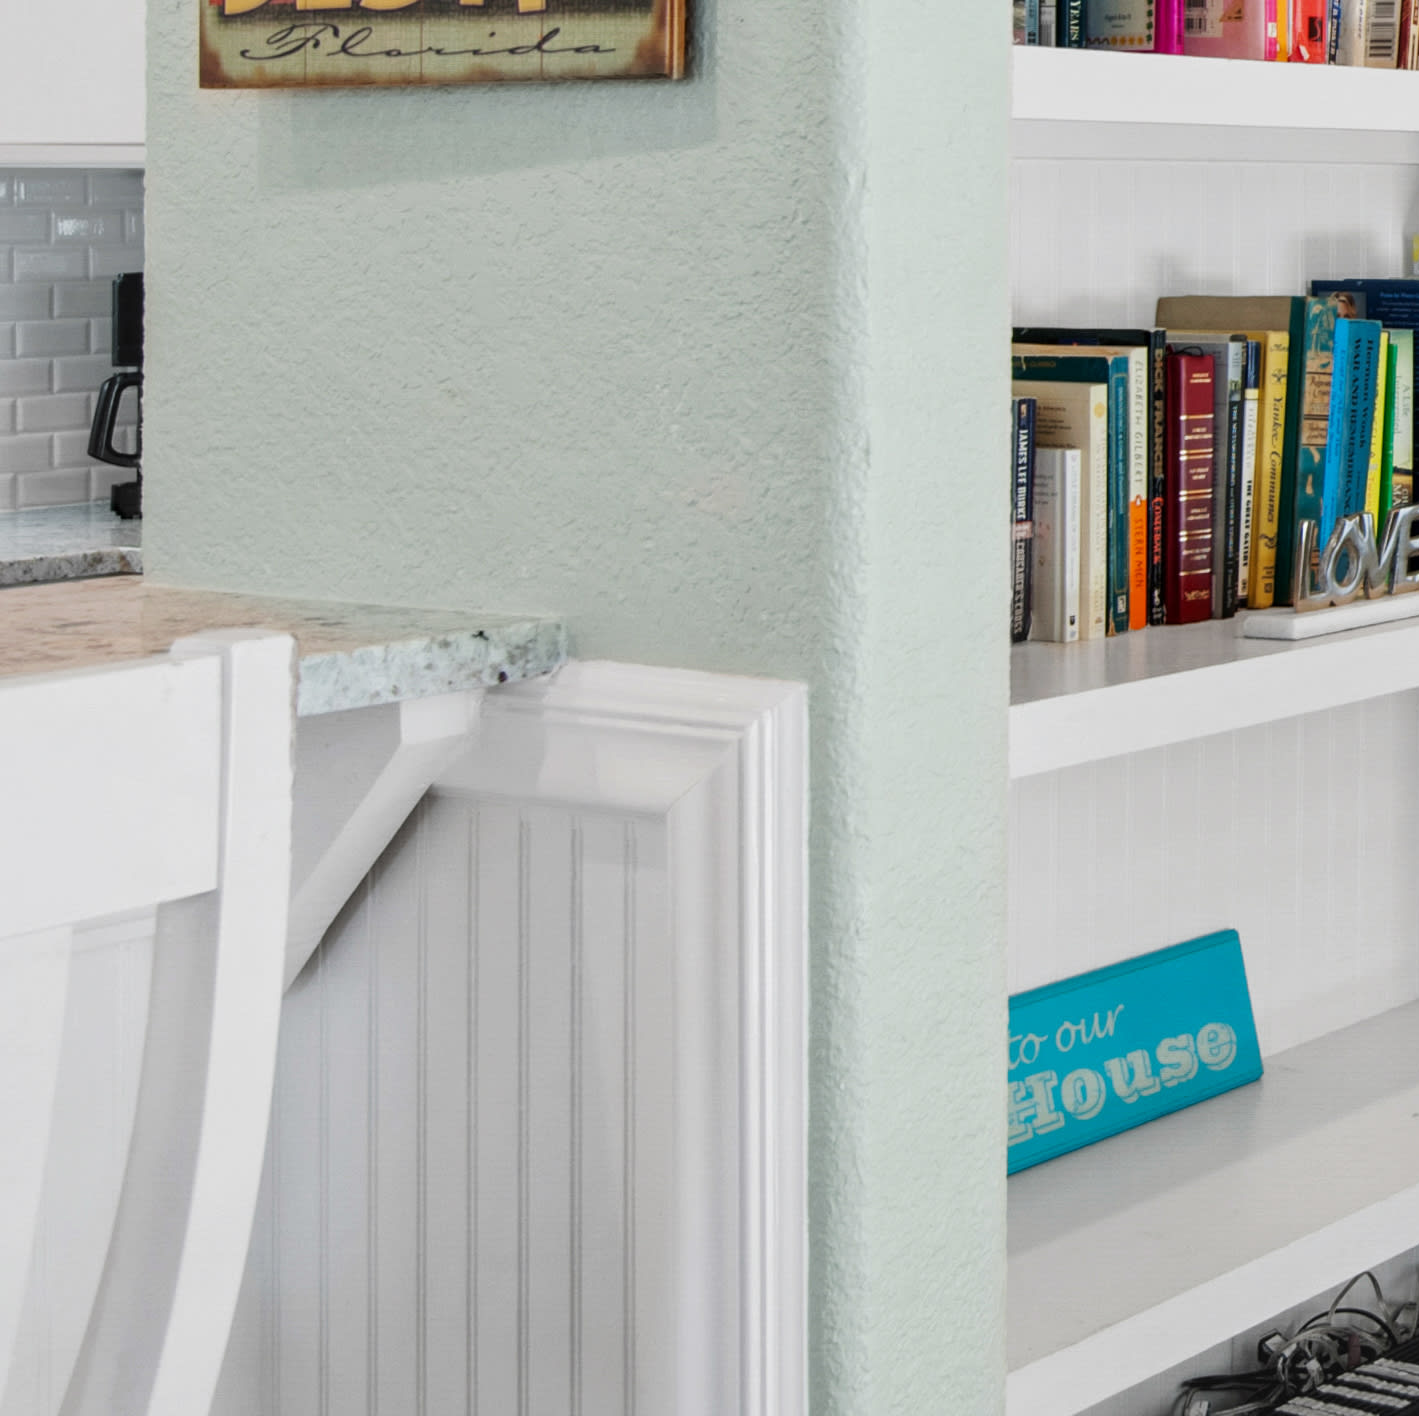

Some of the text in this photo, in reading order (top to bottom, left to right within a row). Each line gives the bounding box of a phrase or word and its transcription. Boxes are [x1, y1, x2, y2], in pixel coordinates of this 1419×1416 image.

[240, 24, 616, 61] Florida
[1070, 0, 1083, 41] YEARS
[1134, 360, 1144, 484] ELIZABETH GILBERT
[1153, 347, 1164, 479] DICK FRANCIS
[1343, 338, 1362, 518] WAR AND REMEMBRANC
[1359, 339, 1374, 449] Herman Wouk
[1017, 429, 1029, 520] JAMES LEE BURKE
[1267, 396, 1284, 524] Yankee Communes
[1134, 518, 1144, 588] STERN MEN
[1151, 496, 1164, 565] COMEBACK
[1007, 1022, 1237, 1147] House
[1008, 1004, 1124, 1070] to our
